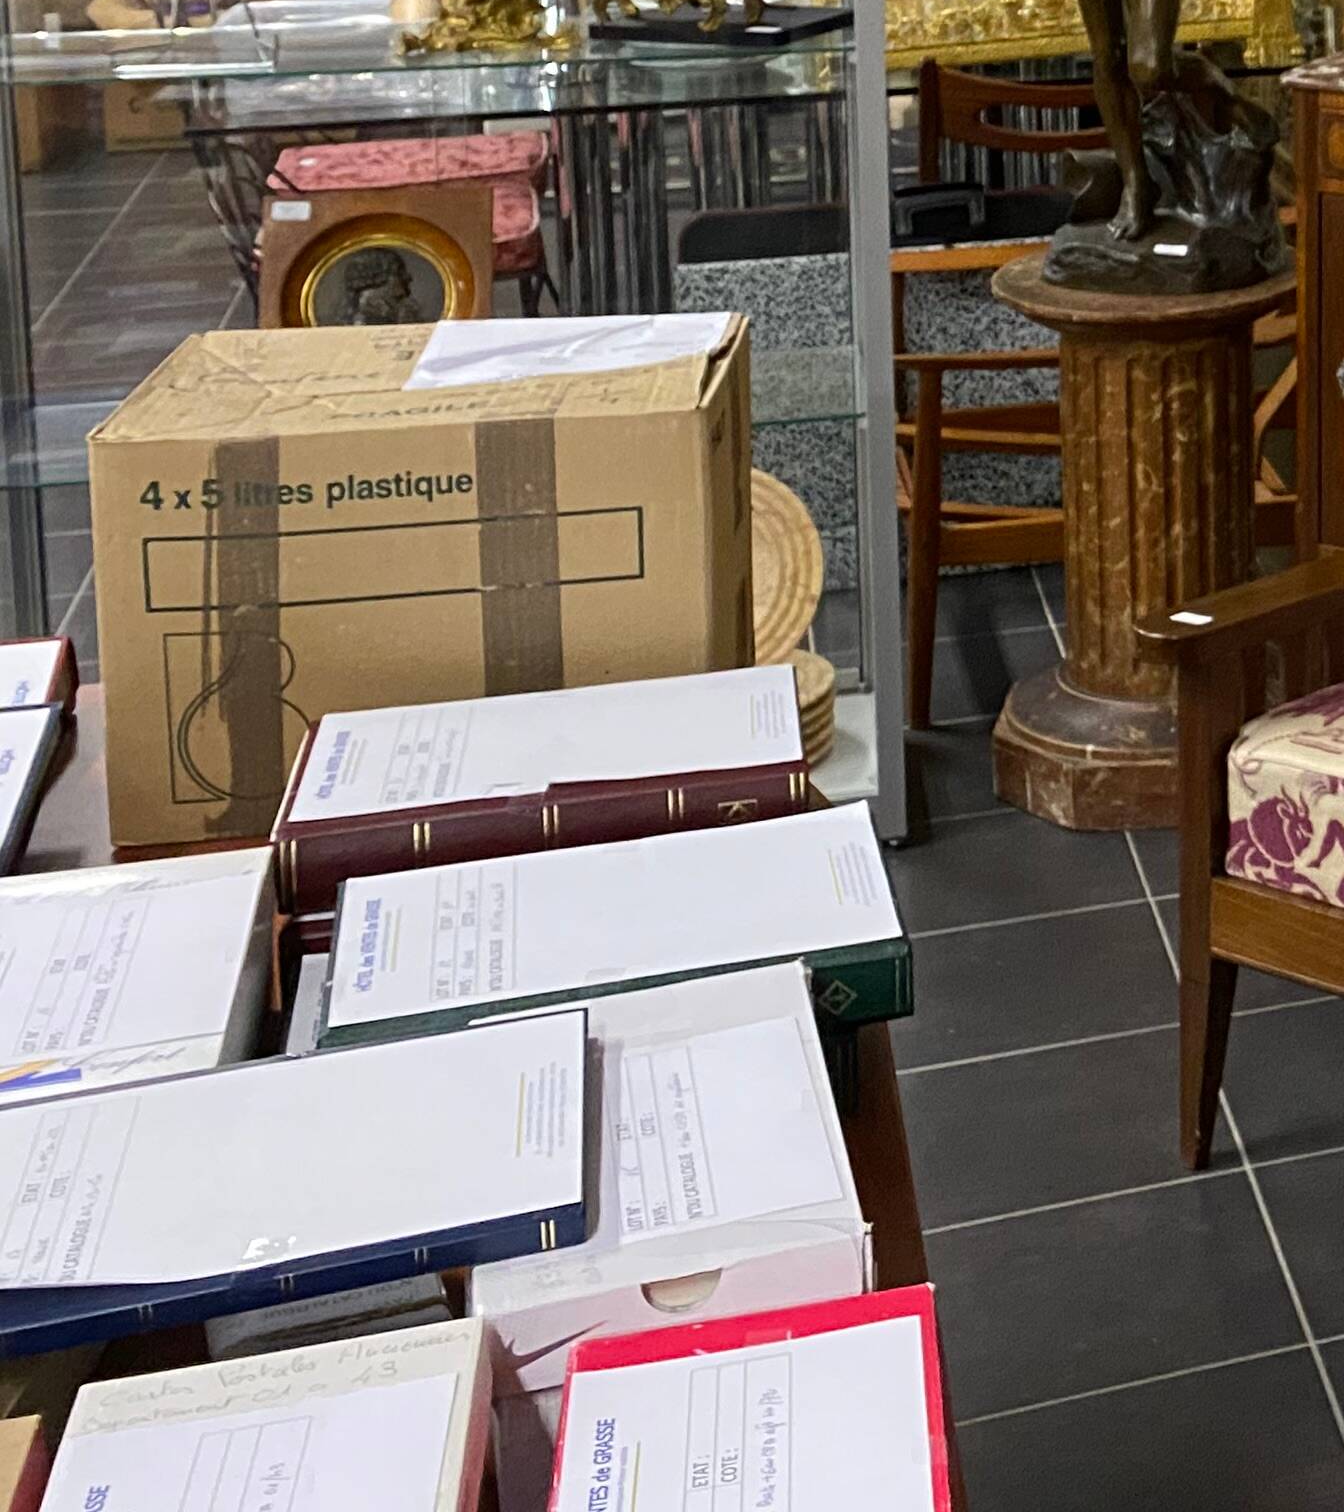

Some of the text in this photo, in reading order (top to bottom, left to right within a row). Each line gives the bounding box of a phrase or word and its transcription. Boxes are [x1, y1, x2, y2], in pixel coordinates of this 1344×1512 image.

[140, 471, 474, 510] 4 x 5 litres plastique
[588, 1418, 617, 1512] NTES de GRASSE
[692, 1461, 710, 1489] ETAT
[721, 1454, 739, 1484] COTE
